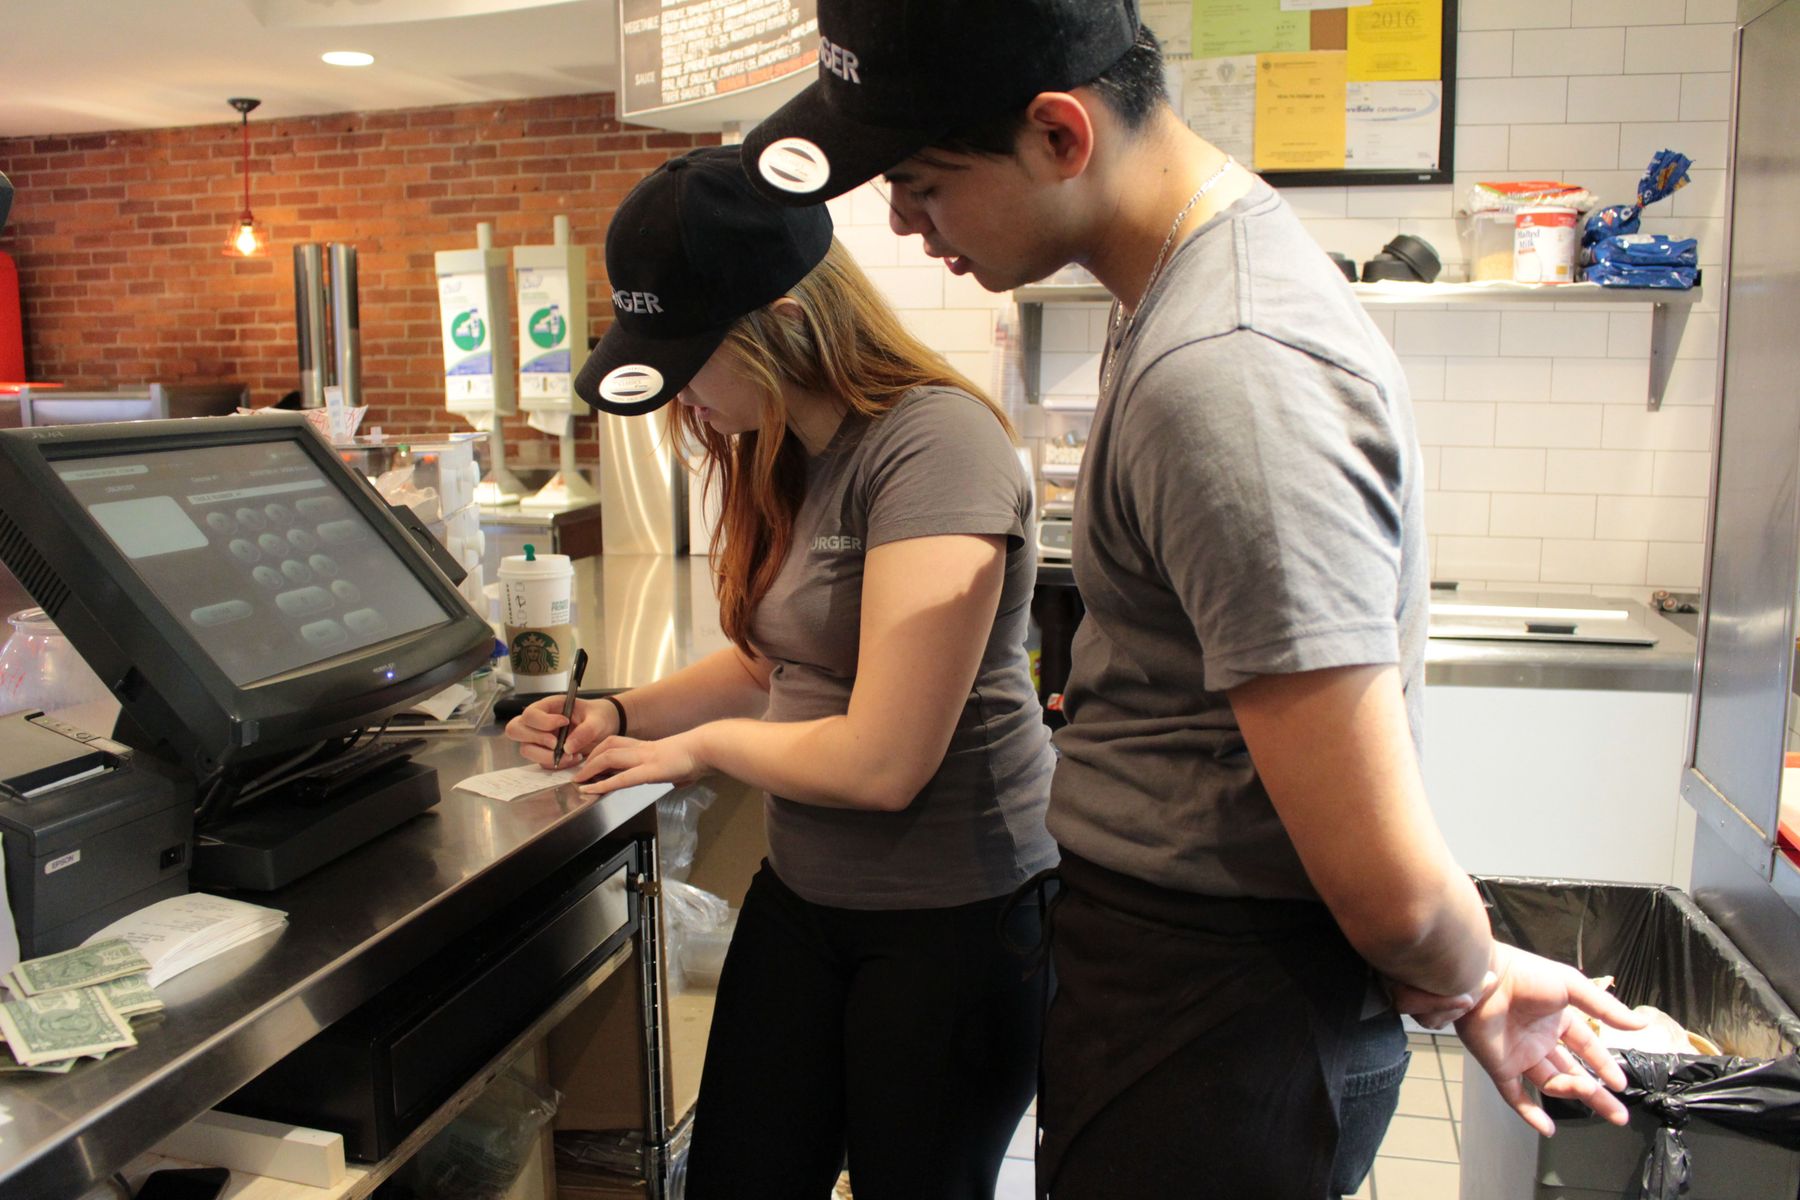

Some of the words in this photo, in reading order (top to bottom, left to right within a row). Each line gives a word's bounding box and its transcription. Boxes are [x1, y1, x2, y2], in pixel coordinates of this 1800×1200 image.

[1371, 11, 1415, 28] 2016
[820, 36, 861, 84] GER
[1519, 240, 1534, 248] Milk
[52, 854, 74, 869] EPSON
